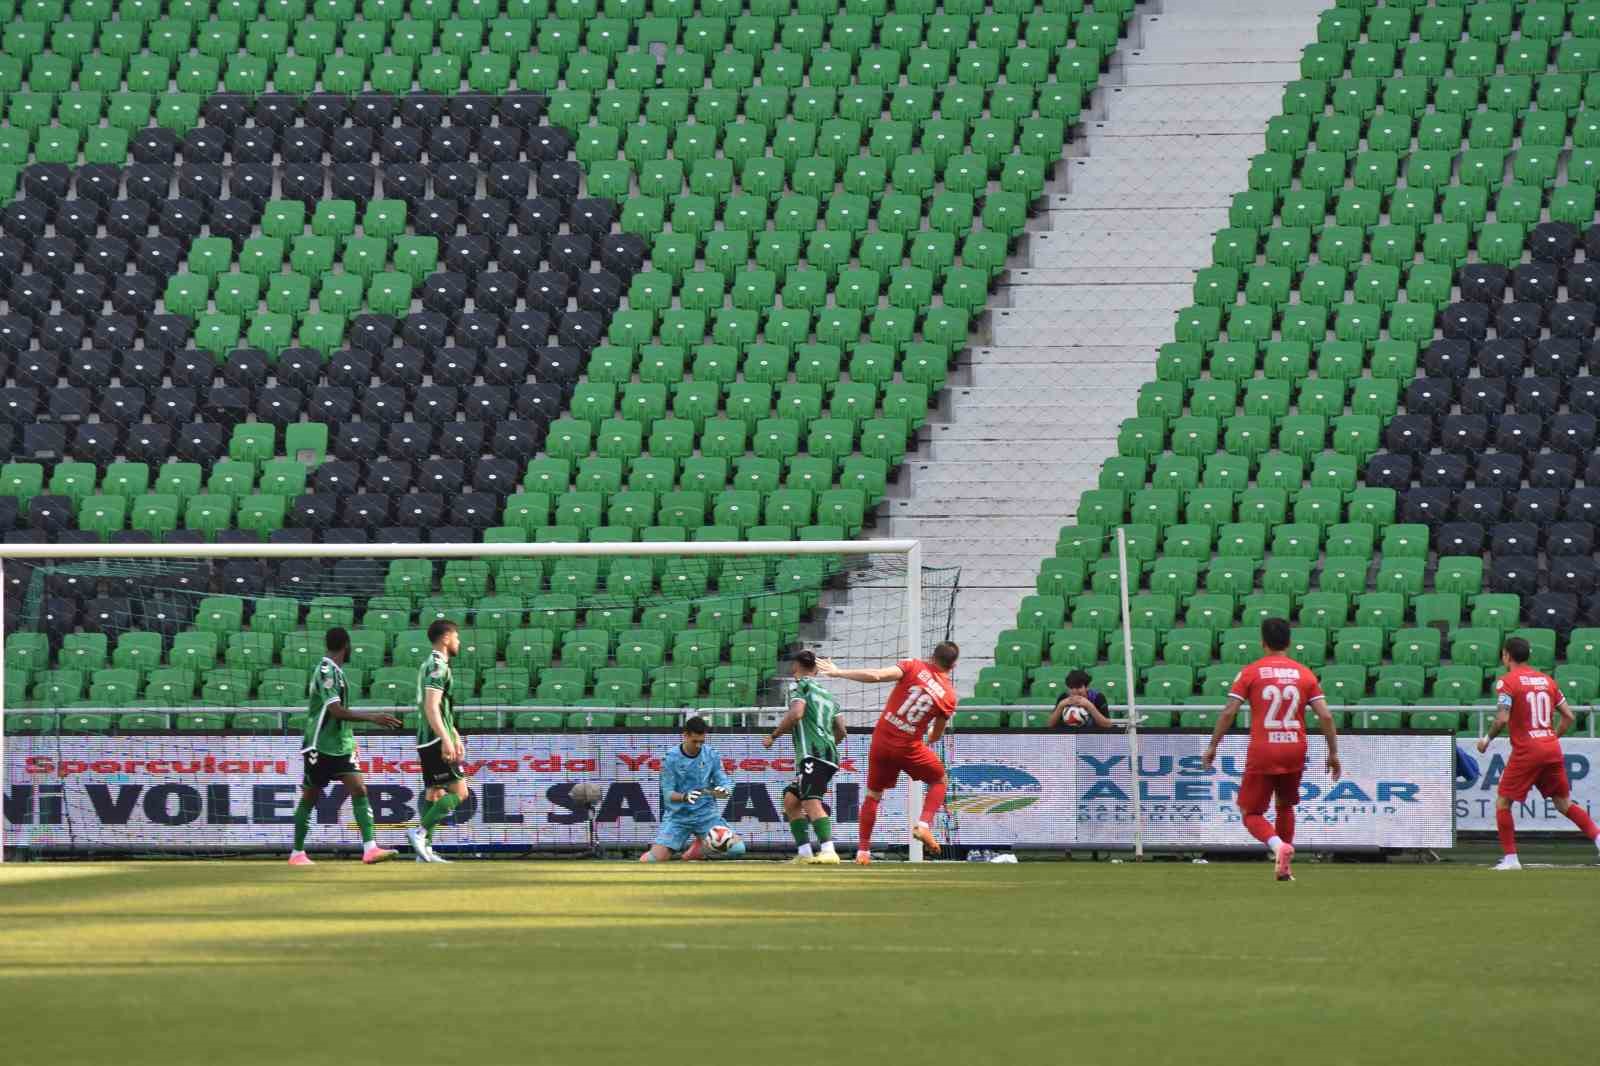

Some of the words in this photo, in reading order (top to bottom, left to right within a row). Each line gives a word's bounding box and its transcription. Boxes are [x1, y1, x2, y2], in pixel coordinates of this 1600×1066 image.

[897, 685, 933, 723] 18
[1262, 685, 1301, 729] 22
[1526, 691, 1551, 729] 10
